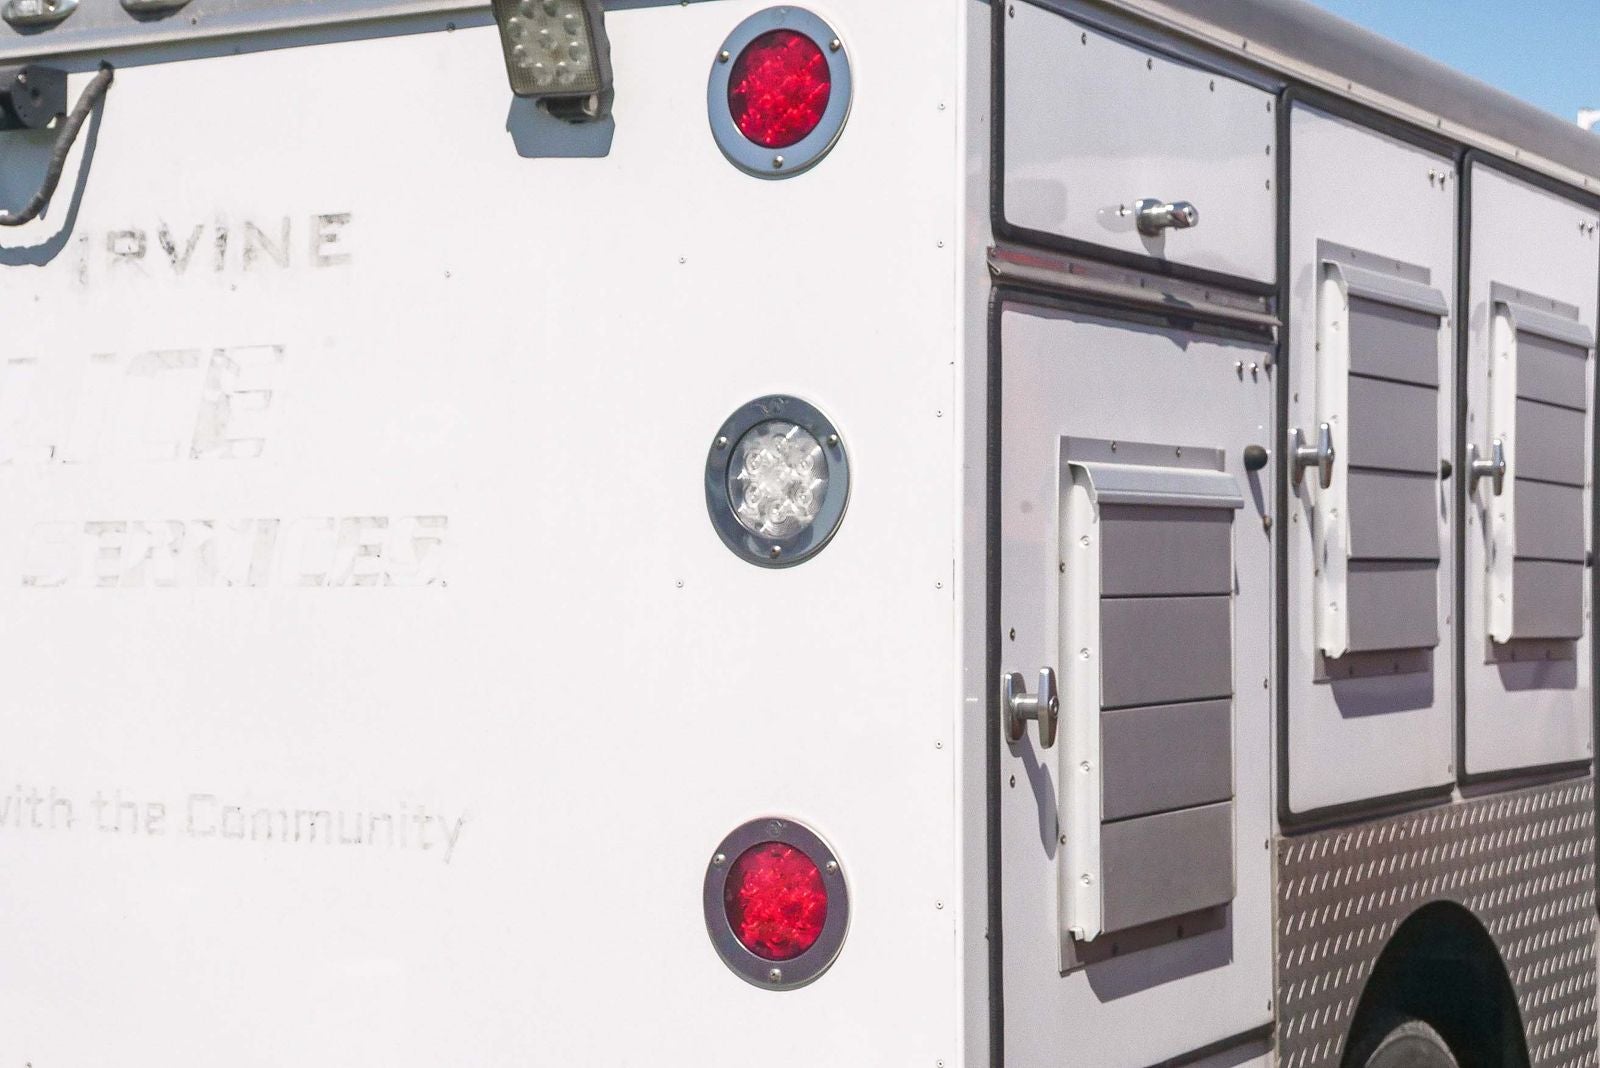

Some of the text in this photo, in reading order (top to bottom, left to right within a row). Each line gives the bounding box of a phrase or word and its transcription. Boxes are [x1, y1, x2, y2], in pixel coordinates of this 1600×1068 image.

[76, 211, 353, 290] IRVINE
[20, 514, 449, 588] SERVICES
[90, 789, 168, 837] the
[186, 792, 469, 865] Community
